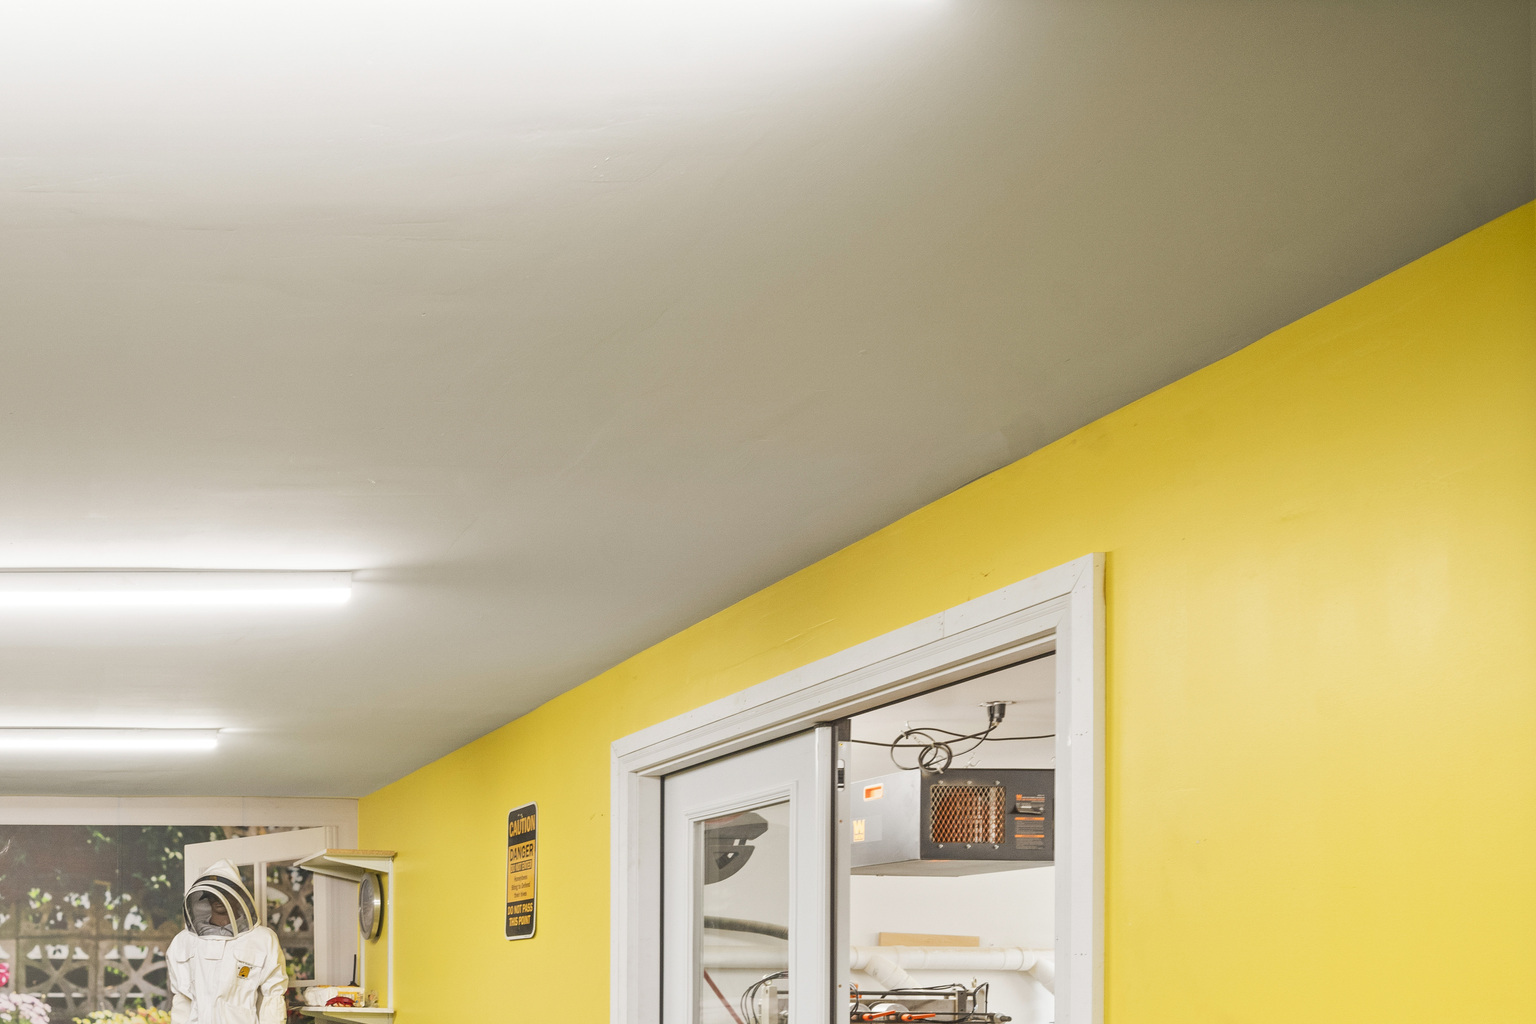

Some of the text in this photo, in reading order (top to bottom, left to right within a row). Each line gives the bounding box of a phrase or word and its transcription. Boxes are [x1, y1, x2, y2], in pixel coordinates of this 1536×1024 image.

[509, 814, 536, 838] CAUTION
[509, 843, 534, 862] DANGER
[508, 902, 533, 915] DO NOT PASS
[509, 915, 531, 926] THIS POINT
